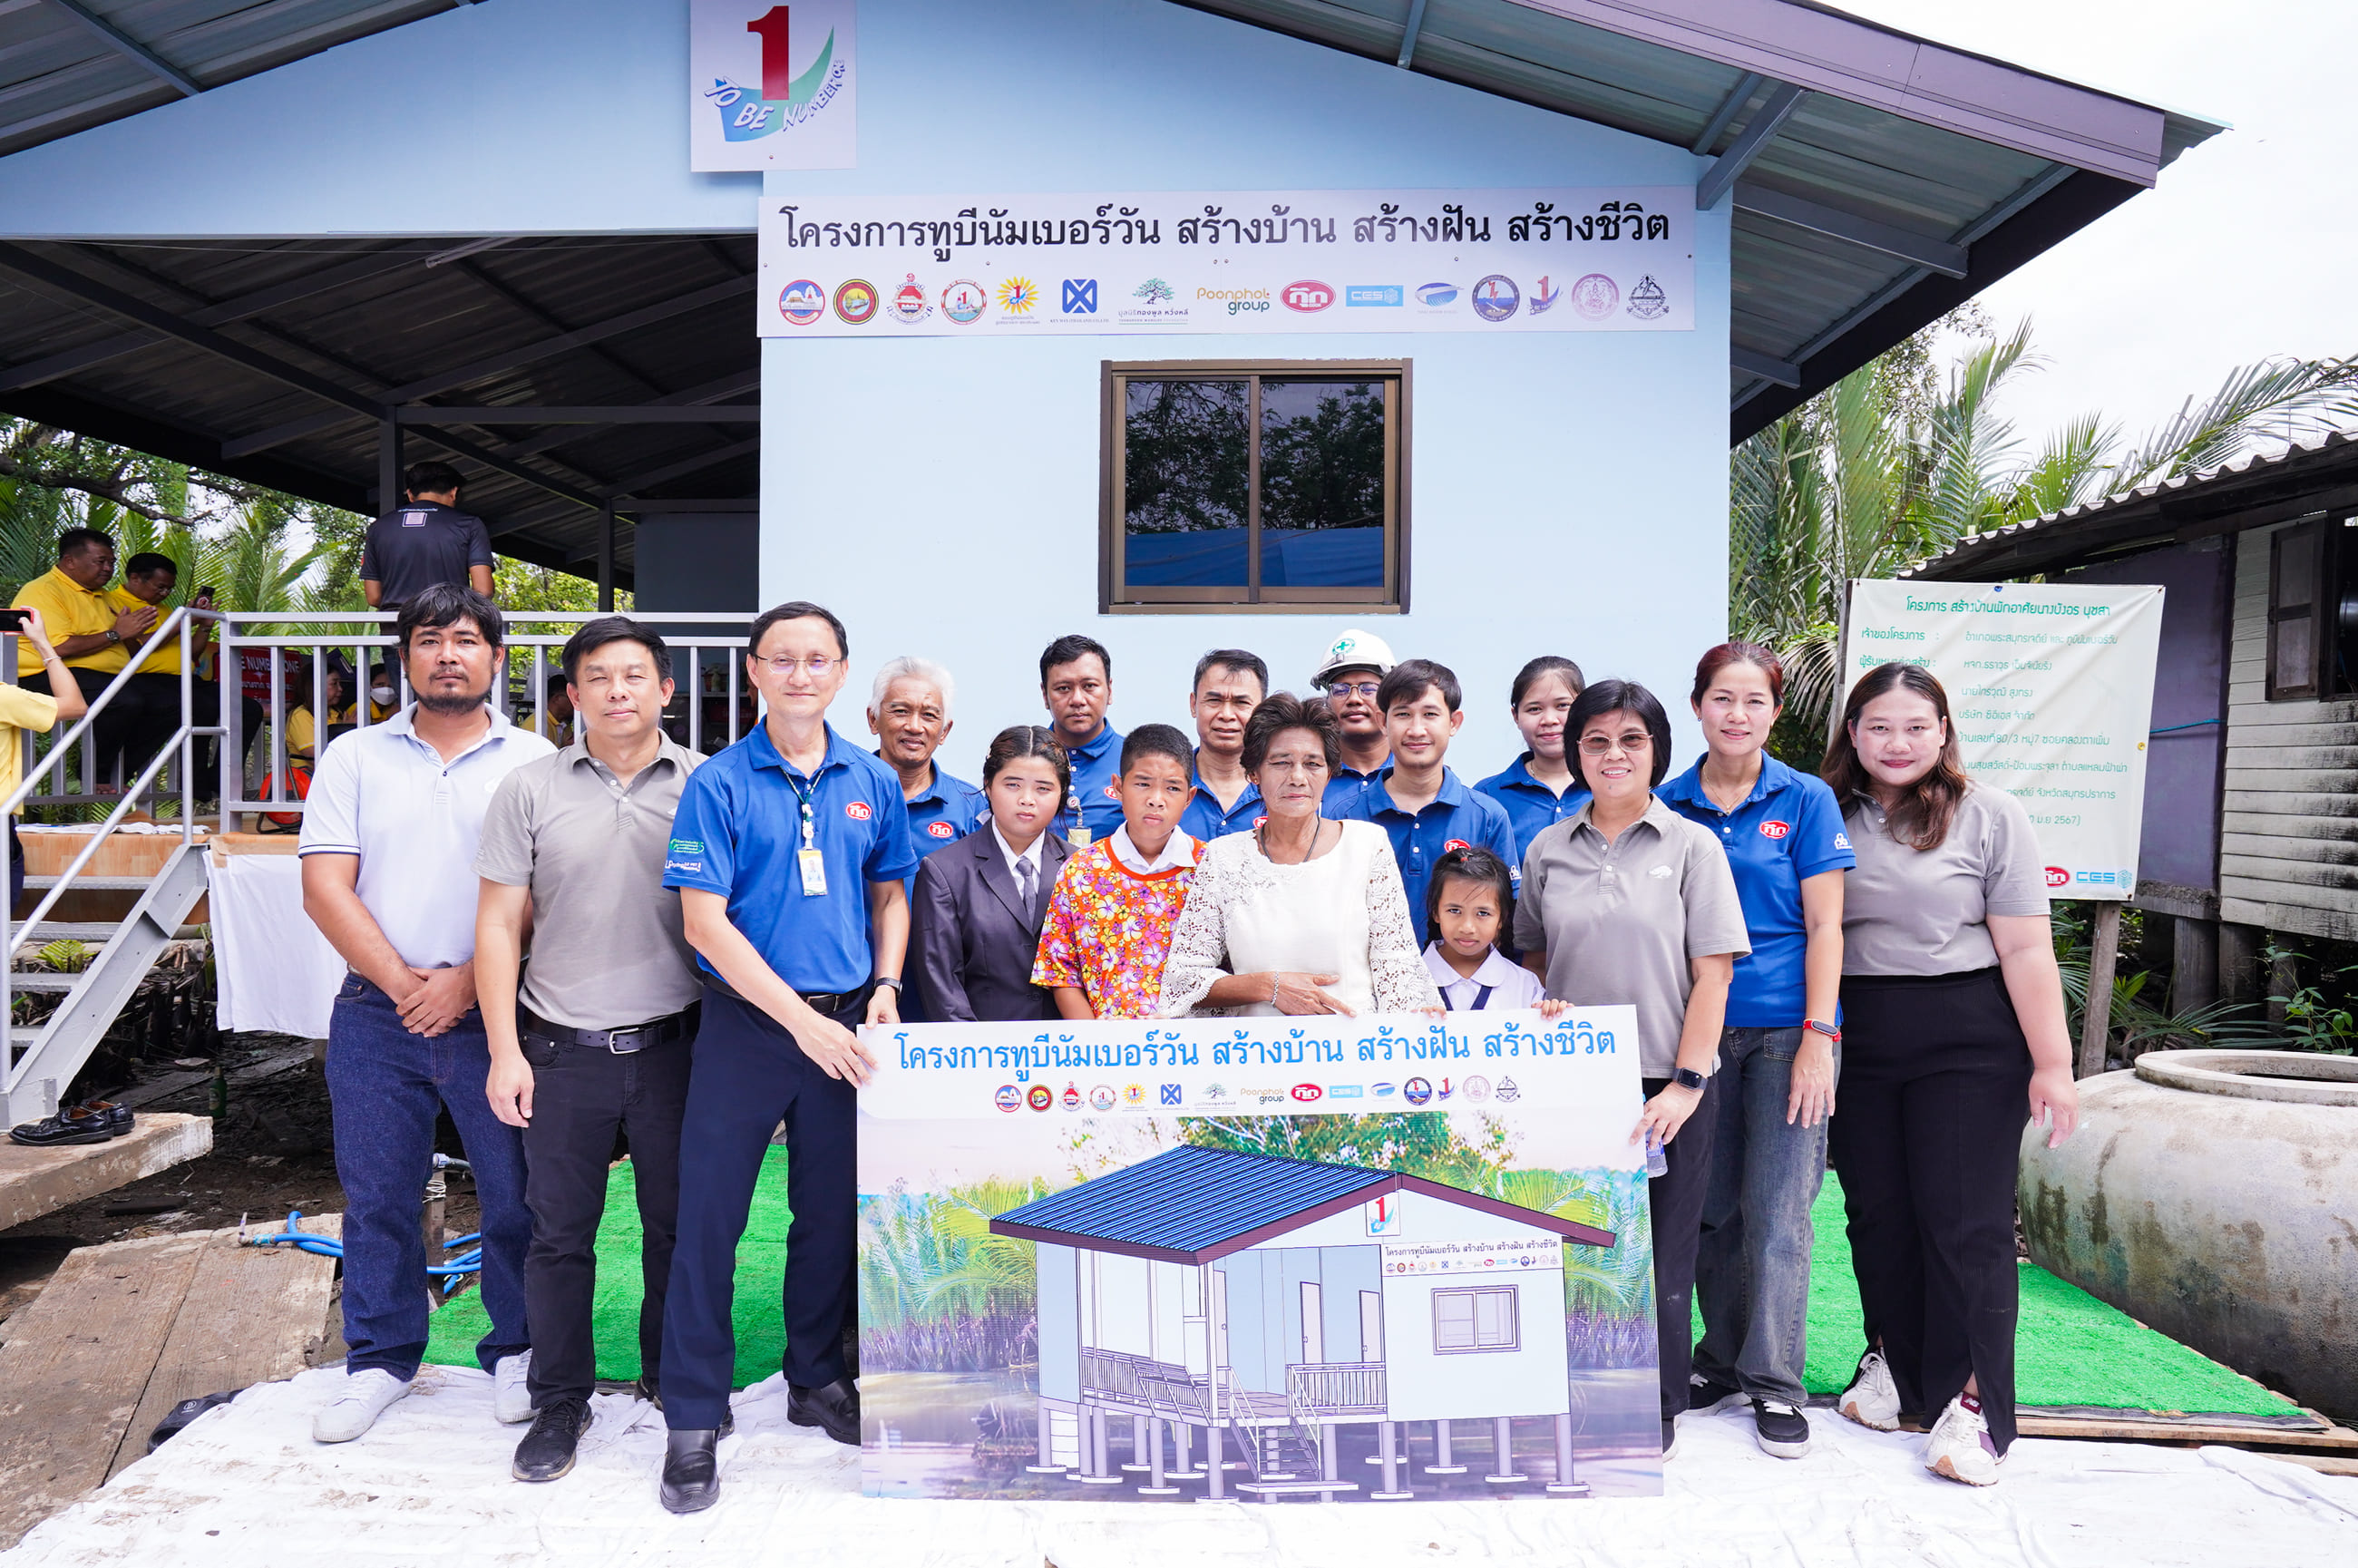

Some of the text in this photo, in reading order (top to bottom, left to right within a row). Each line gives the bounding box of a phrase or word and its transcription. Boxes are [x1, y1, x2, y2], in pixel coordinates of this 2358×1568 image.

[746, 5, 789, 101] 1
[704, 76, 742, 108] TO
[734, 102, 775, 131] BE
[783, 78, 843, 131] NUMBER
[779, 201, 1670, 262] โครงการทูบีนัมเบอร์วัน สร้างบ้าน สร้างฝัน สร้างชีวิต
[1351, 291, 1383, 302] CES
[1228, 301, 1270, 316] group
[1906, 596, 1947, 611] โครงการ
[2083, 606, 2110, 618] นุชสา
[1862, 626, 1925, 640] เจ้าของโครงการ
[247, 657, 271, 671] NUMB
[1959, 710, 1983, 719] บริษัท
[2036, 787, 2116, 801] จังหวัดสมุทรปราการ
[2076, 872, 2115, 882] CES
[893, 1020, 1616, 1082] โครงการทูบีนัมเบอร์วัน สร้างบ้าน สร้างฝัน สร้างชีวิต
[1259, 1094, 1284, 1105] group
